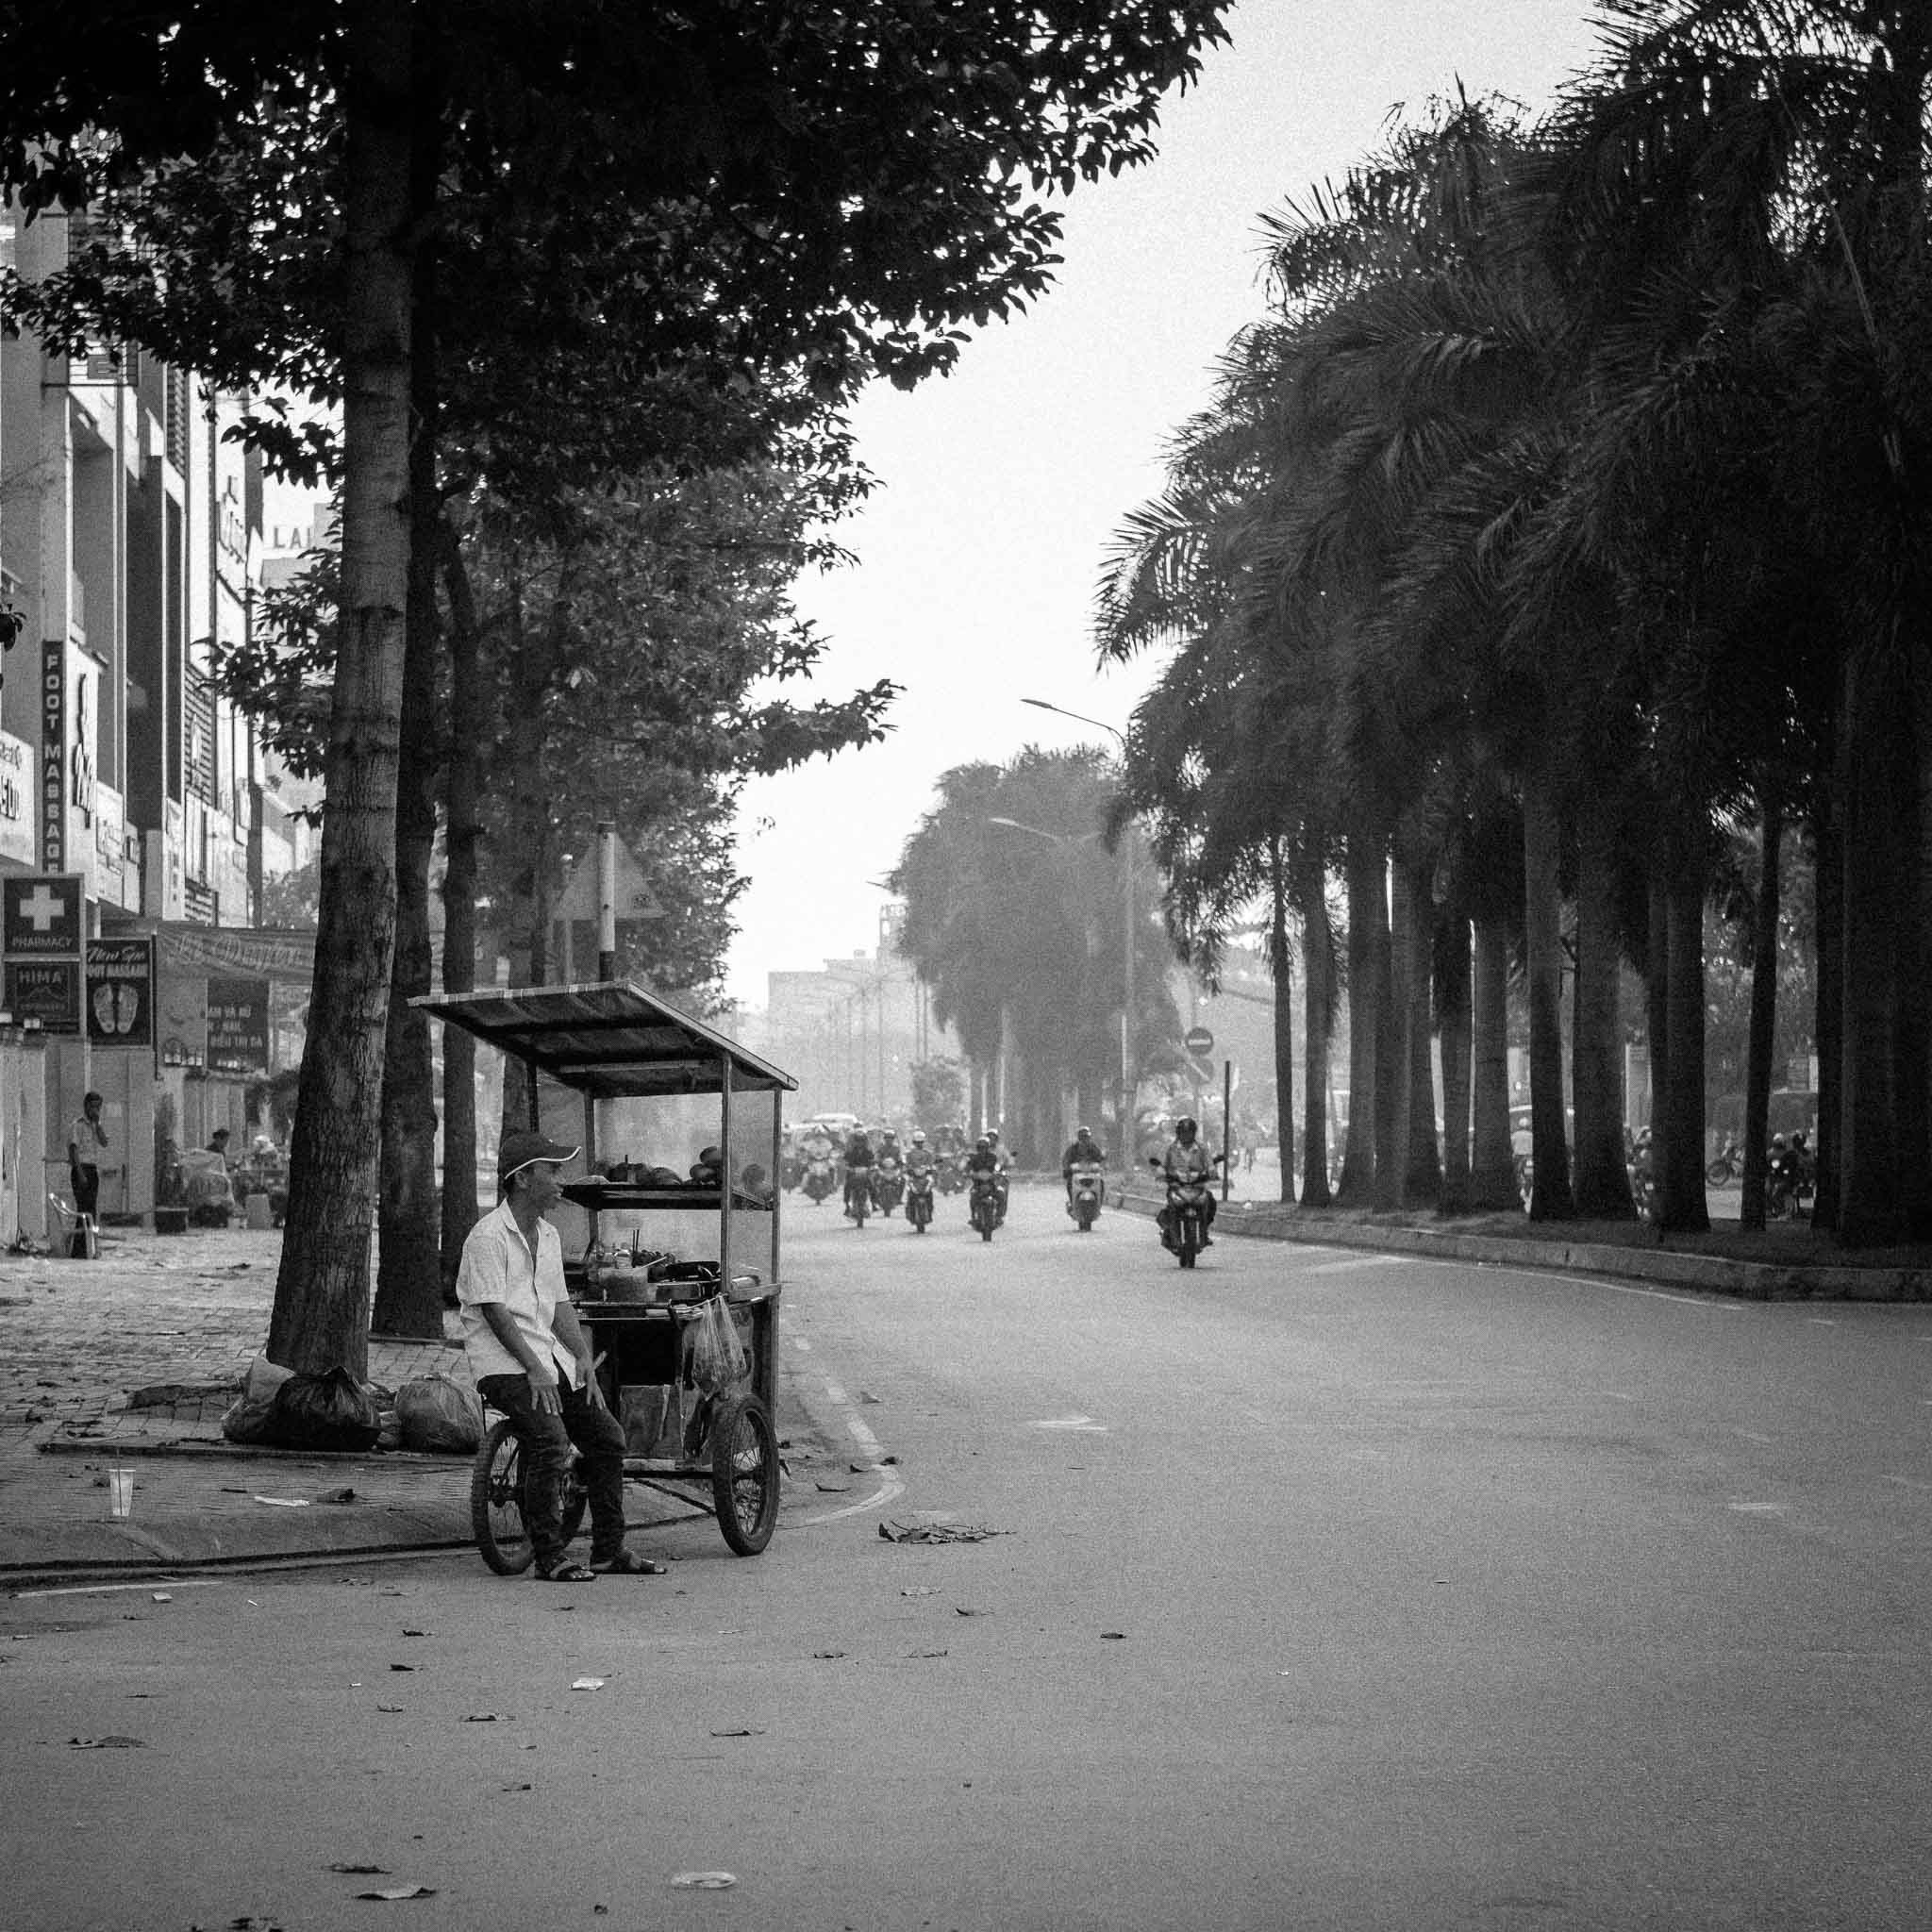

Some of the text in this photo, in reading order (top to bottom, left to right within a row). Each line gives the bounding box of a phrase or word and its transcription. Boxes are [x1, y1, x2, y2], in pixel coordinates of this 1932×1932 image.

[44, 655, 61, 873] FOOT MASSAGE
[11, 935, 73, 948] PHARMACY
